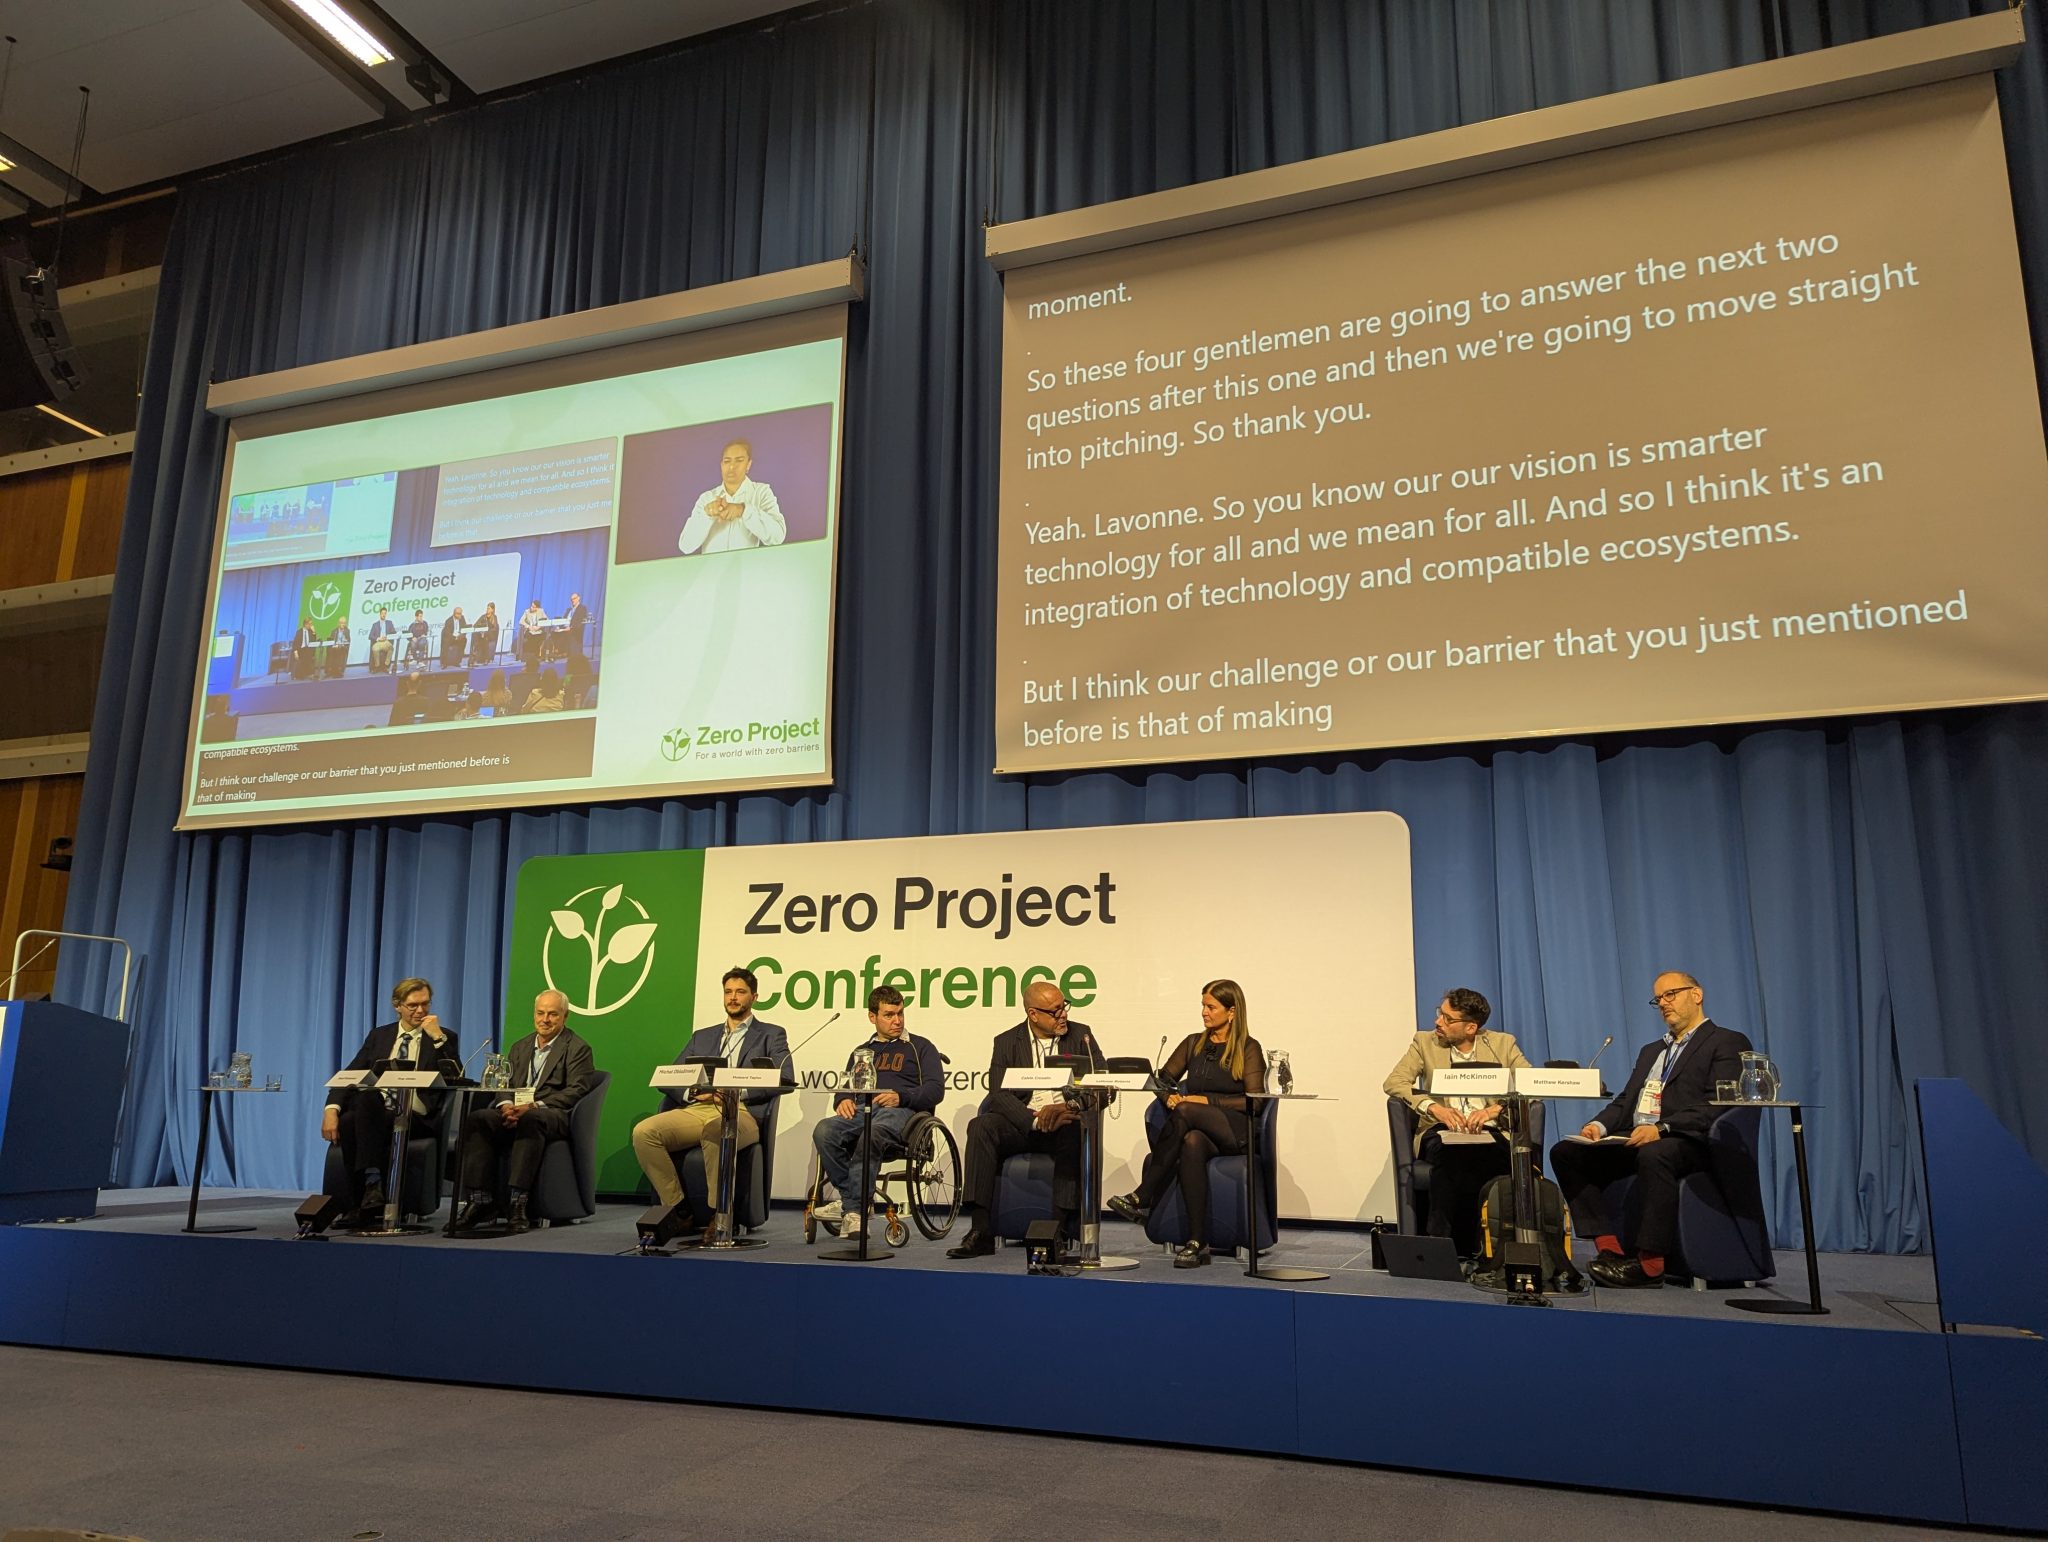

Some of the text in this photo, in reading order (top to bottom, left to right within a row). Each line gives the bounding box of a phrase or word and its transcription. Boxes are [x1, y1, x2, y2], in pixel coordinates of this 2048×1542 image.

[1027, 234, 1839, 393] So these four gentlemen are going to answer the next two
[1028, 281, 1132, 320] moment.
[1026, 261, 1920, 437] questions after this one and then we're going to move straight
[1026, 402, 1371, 470] into pitching. So thank you.
[1024, 427, 1768, 545] Yeah. Lavonne. So you know our our vision is smarter
[1024, 461, 1884, 585] technology for all and we mean for all. And so I think it's an
[364, 571, 456, 594] Zero Project
[1024, 521, 1800, 629] integration of technology and compatible ecosystems.
[1023, 588, 1968, 705] But I think our challenge or our barrier that you just mentioned
[696, 718, 820, 745] Zero Project
[1023, 700, 1333, 747] before is that of making
[200, 754, 510, 788] But I think our challenge or our barrier that you just mentioned before is
[204, 743, 300, 760] compatible ecosystems.
[695, 751, 709, 760] For
[719, 749, 743, 758] world
[745, 747, 763, 756] with
[765, 746, 784, 755] zero
[786, 743, 820, 753] barriers
[197, 790, 257, 803] that of making
[744, 872, 1116, 940] Zero Project
[1444, 1072, 1498, 1080] Iain McKinnon
